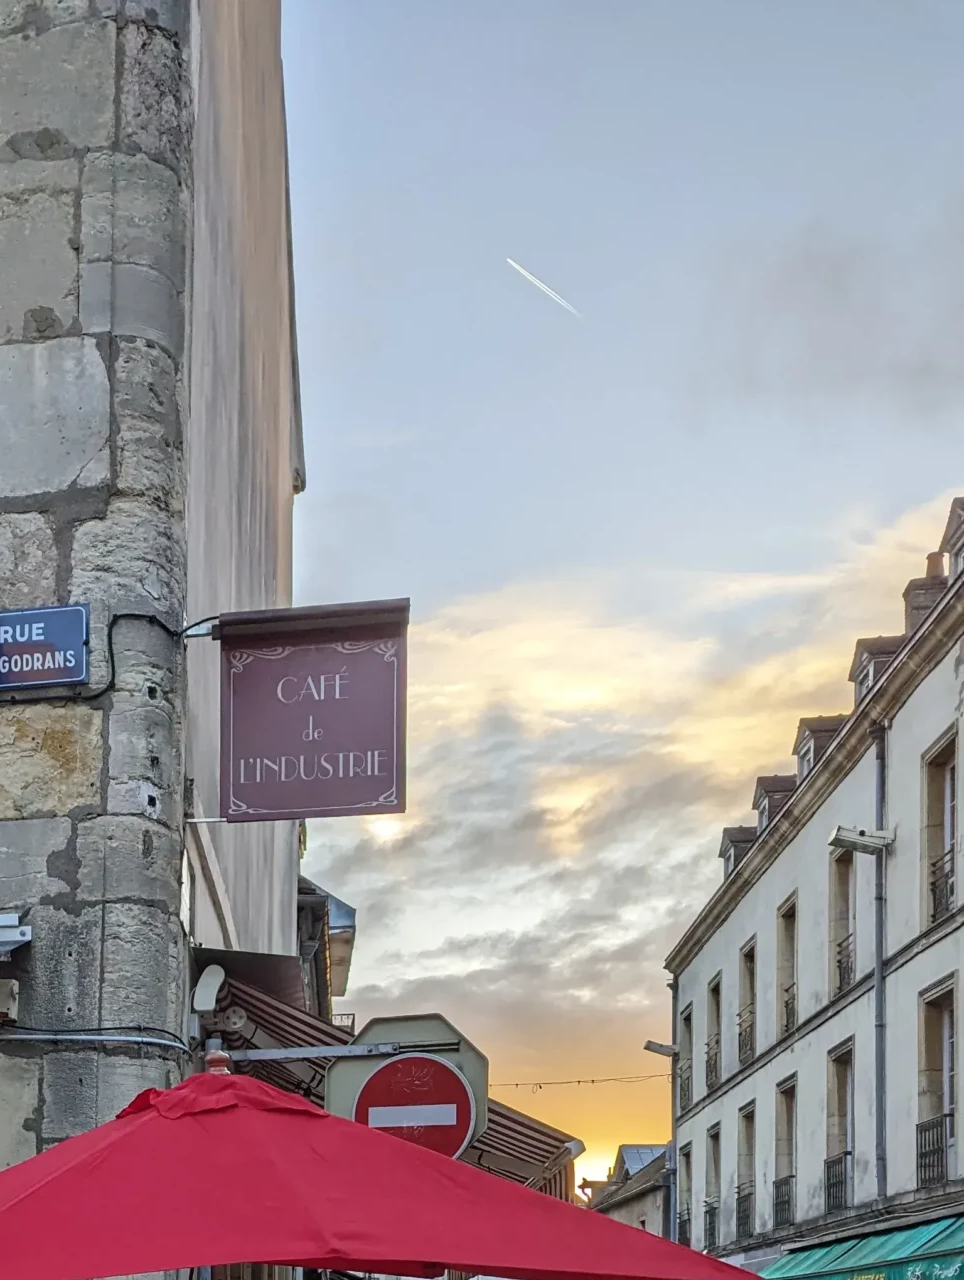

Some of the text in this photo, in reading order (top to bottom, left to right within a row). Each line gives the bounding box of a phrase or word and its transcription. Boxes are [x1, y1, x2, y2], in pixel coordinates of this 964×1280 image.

[0, 622, 45, 644] RUE
[0, 650, 76, 674] GODRANS
[276, 665, 350, 704] CAFÉ
[302, 715, 324, 741] de
[239, 749, 388, 785] L'INDUSTRIE
